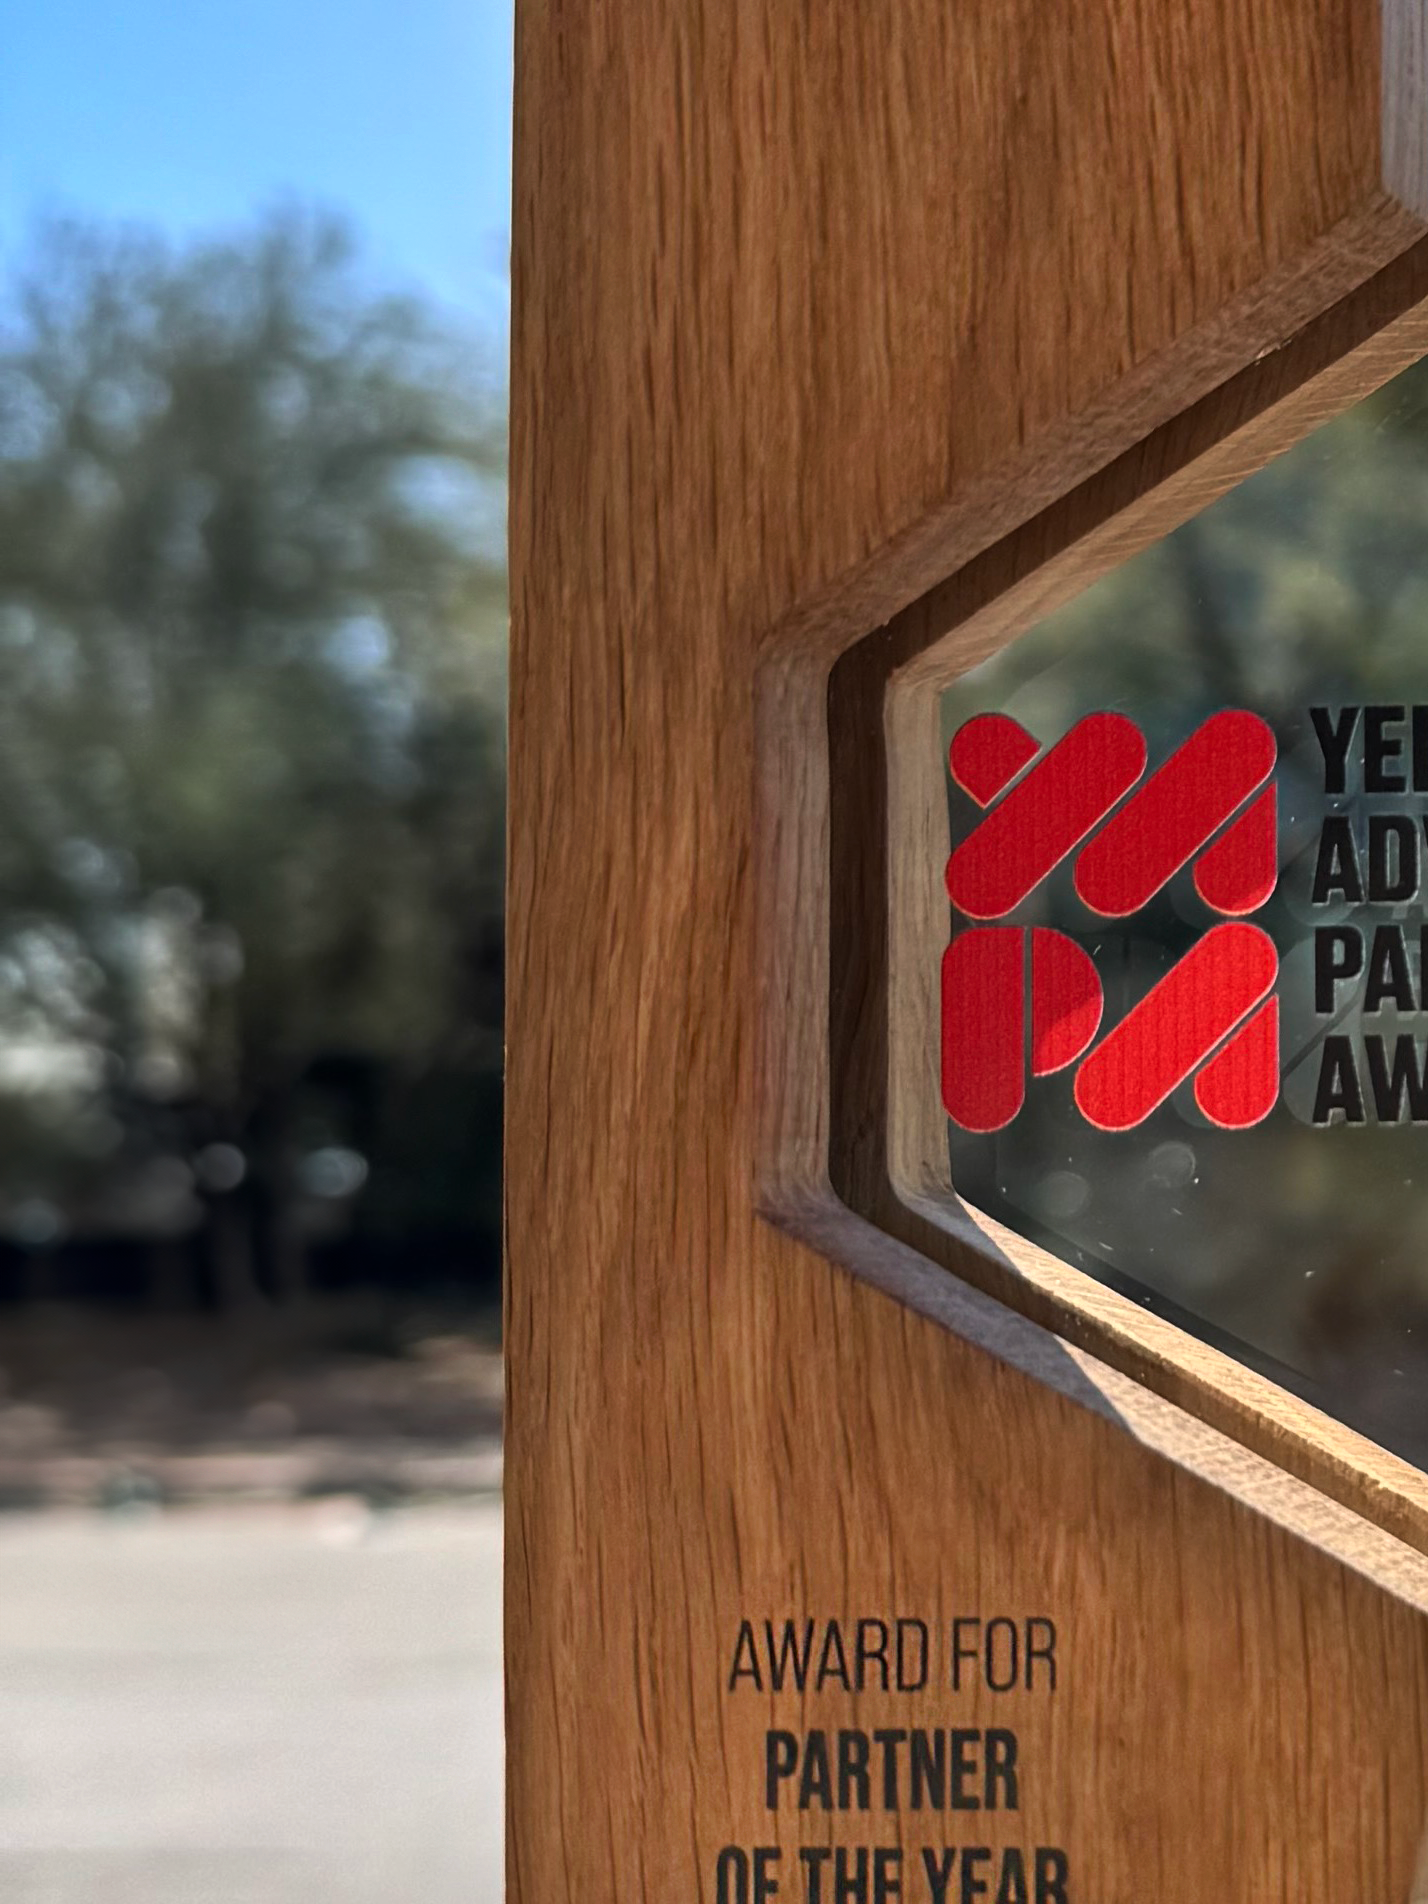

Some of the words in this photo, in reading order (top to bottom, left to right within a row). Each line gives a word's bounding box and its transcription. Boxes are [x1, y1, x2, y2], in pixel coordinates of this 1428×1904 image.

[729, 1618, 927, 1692] AWARD
[951, 1617, 1056, 1691] FOR
[766, 1728, 1019, 1811] PARTNER
